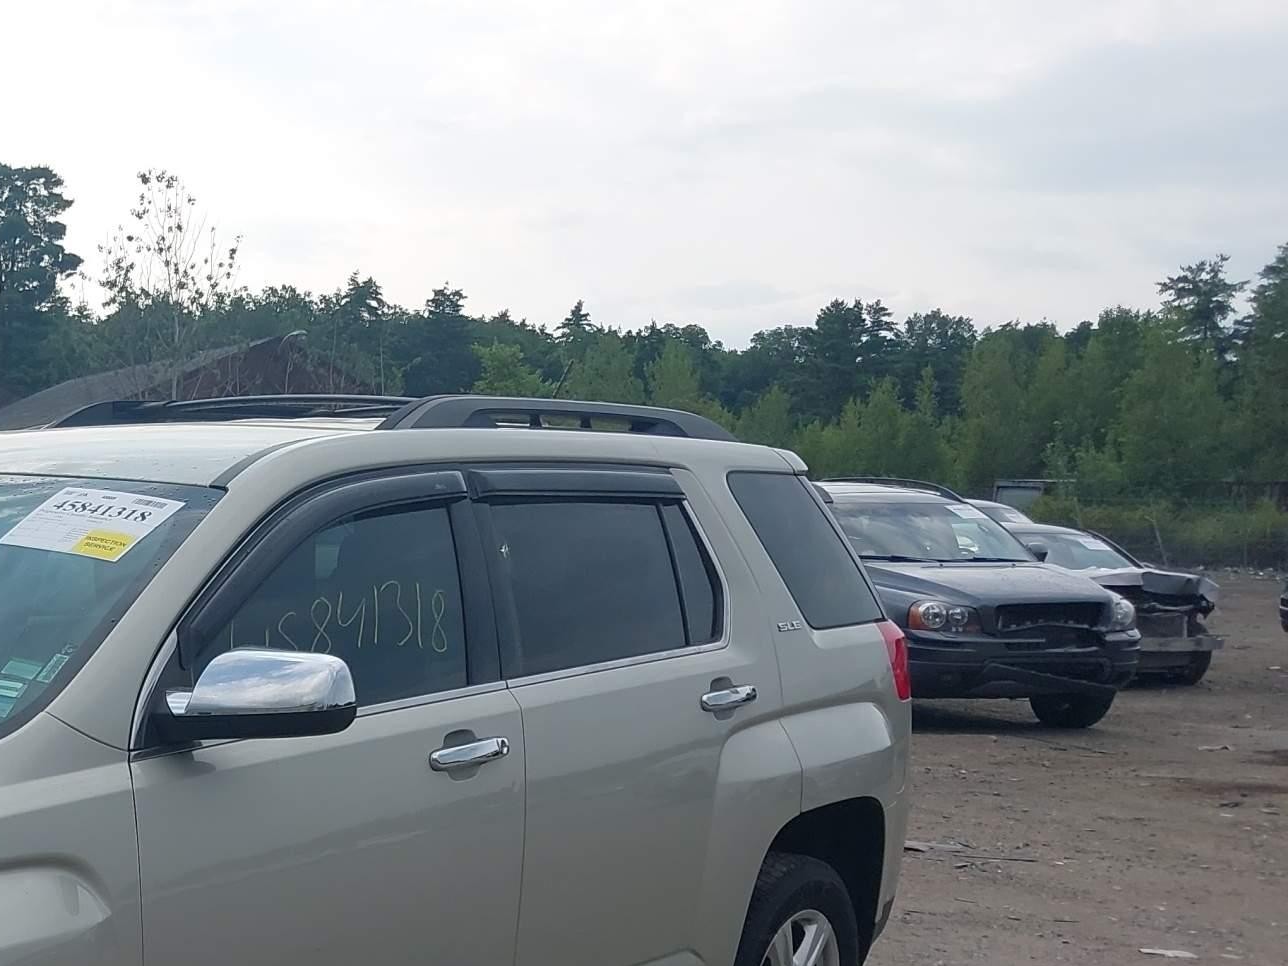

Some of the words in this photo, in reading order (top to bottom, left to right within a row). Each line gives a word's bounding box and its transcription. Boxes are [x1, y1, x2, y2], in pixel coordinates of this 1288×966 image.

[53, 500, 153, 522] 45841318
[83, 541, 116, 552] SERVICE
[86, 535, 128, 548] INSPECTION
[776, 620, 802, 633] SLE
